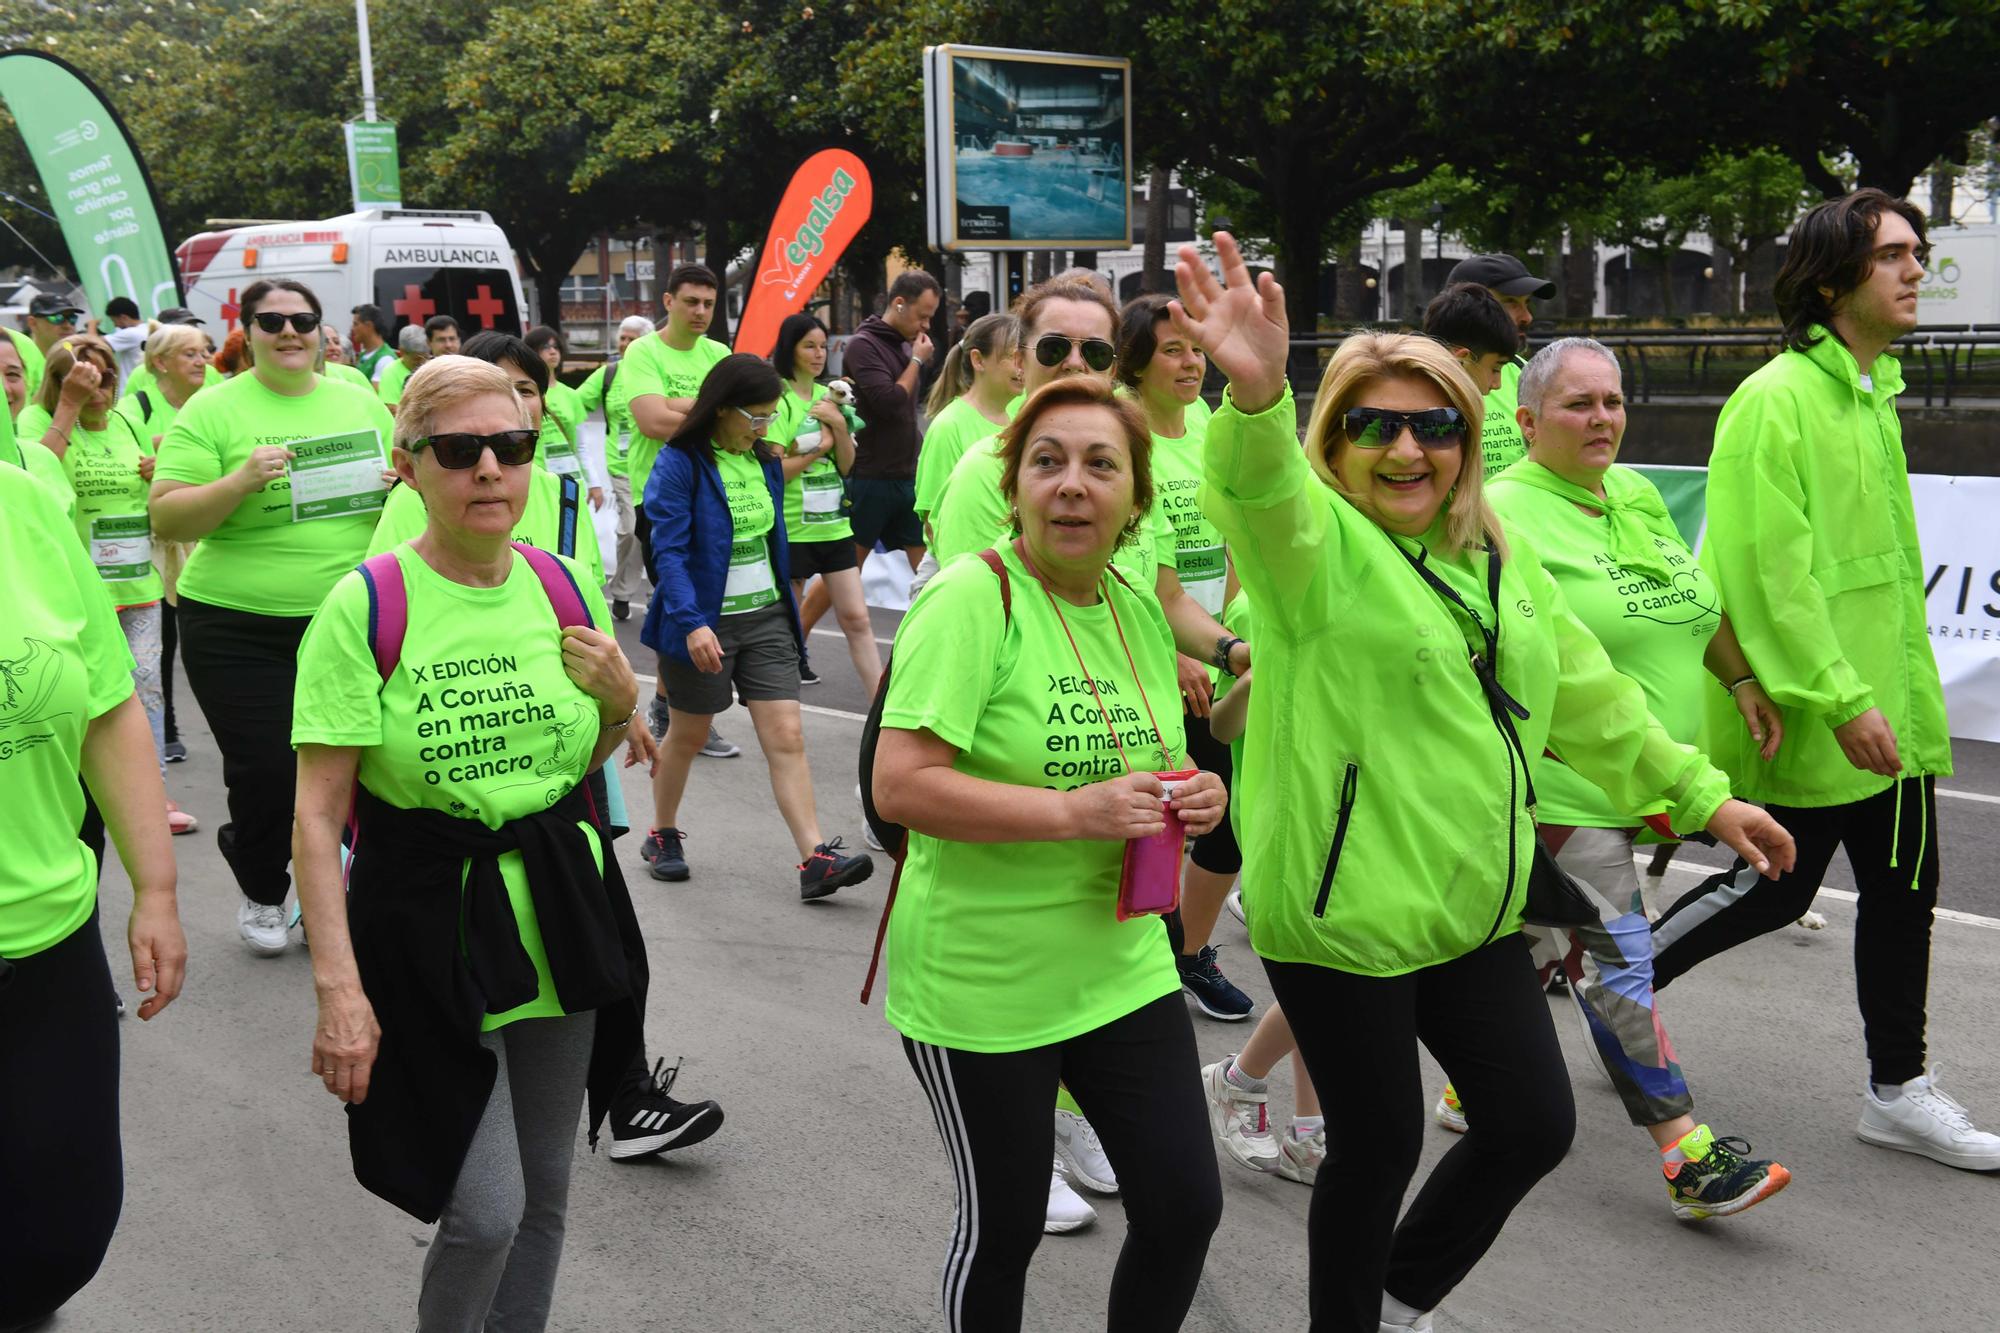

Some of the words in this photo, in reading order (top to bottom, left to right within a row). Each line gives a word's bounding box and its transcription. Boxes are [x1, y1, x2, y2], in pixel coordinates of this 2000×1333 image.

[384, 248, 500, 264] AMBULANCIA
[254, 436, 262, 445] X
[1482, 437, 1522, 450] marcha
[295, 446, 313, 458] Eu
[315, 441, 353, 455] estou
[75, 460, 83, 468] A
[87, 459, 126, 469] Coruña
[75, 469, 91, 478] en
[75, 478, 118, 488] contra
[1157, 483, 1166, 493] X
[76, 490, 86, 498] o
[88, 487, 129, 497] cancro
[730, 500, 763, 514] marcha
[1163, 498, 1172, 510] A
[98, 520, 112, 530] Eu
[1184, 556, 1214, 569] estou
[1593, 554, 1607, 566] A
[1607, 567, 1632, 581] En
[1664, 554, 1686, 567] ha
[1626, 601, 1639, 614] o
[1642, 588, 1697, 610] cancro
[411, 666, 428, 685] X
[432, 652, 518, 681] EDICIÓN
[415, 692, 434, 715] A
[440, 681, 535, 711] Coruña
[417, 718, 452, 739] en
[459, 701, 556, 733] marcha
[1047, 702, 1066, 725] A
[1070, 703, 1140, 725] Coruña
[1046, 734, 1080, 752] en
[1086, 725, 1162, 751] marcha
[419, 735, 506, 763] contra
[424, 769, 441, 786] o
[447, 754, 533, 784] cancro
[1043, 755, 1122, 778] contra
